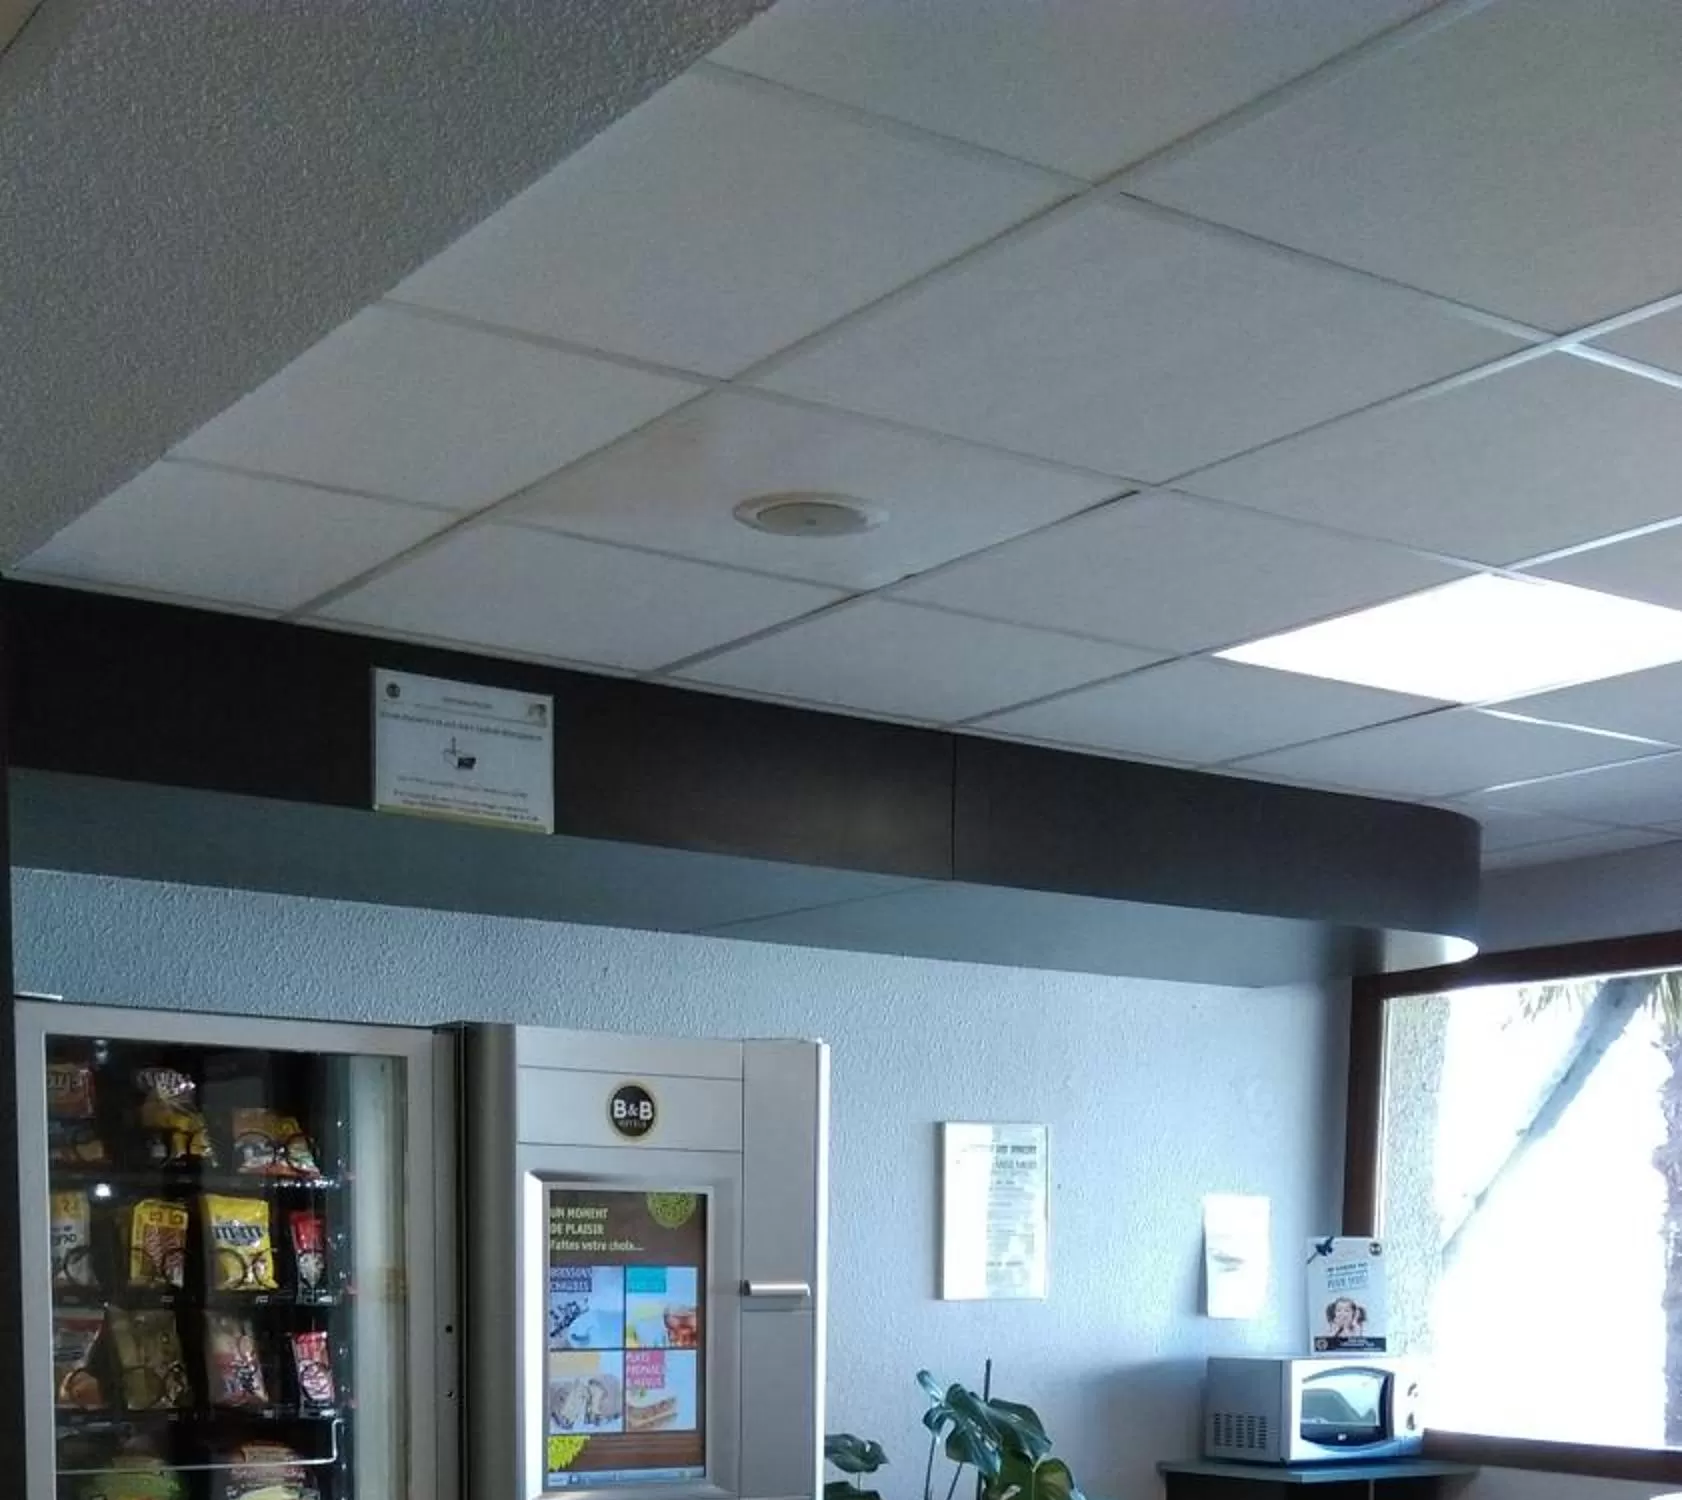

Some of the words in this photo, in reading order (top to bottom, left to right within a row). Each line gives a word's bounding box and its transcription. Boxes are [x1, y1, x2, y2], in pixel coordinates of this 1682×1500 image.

[613, 1099, 653, 1120] B&B
[567, 1207, 608, 1219] MOMENT
[550, 1223, 564, 1235] DE
[565, 1223, 605, 1235] PLAISIR
